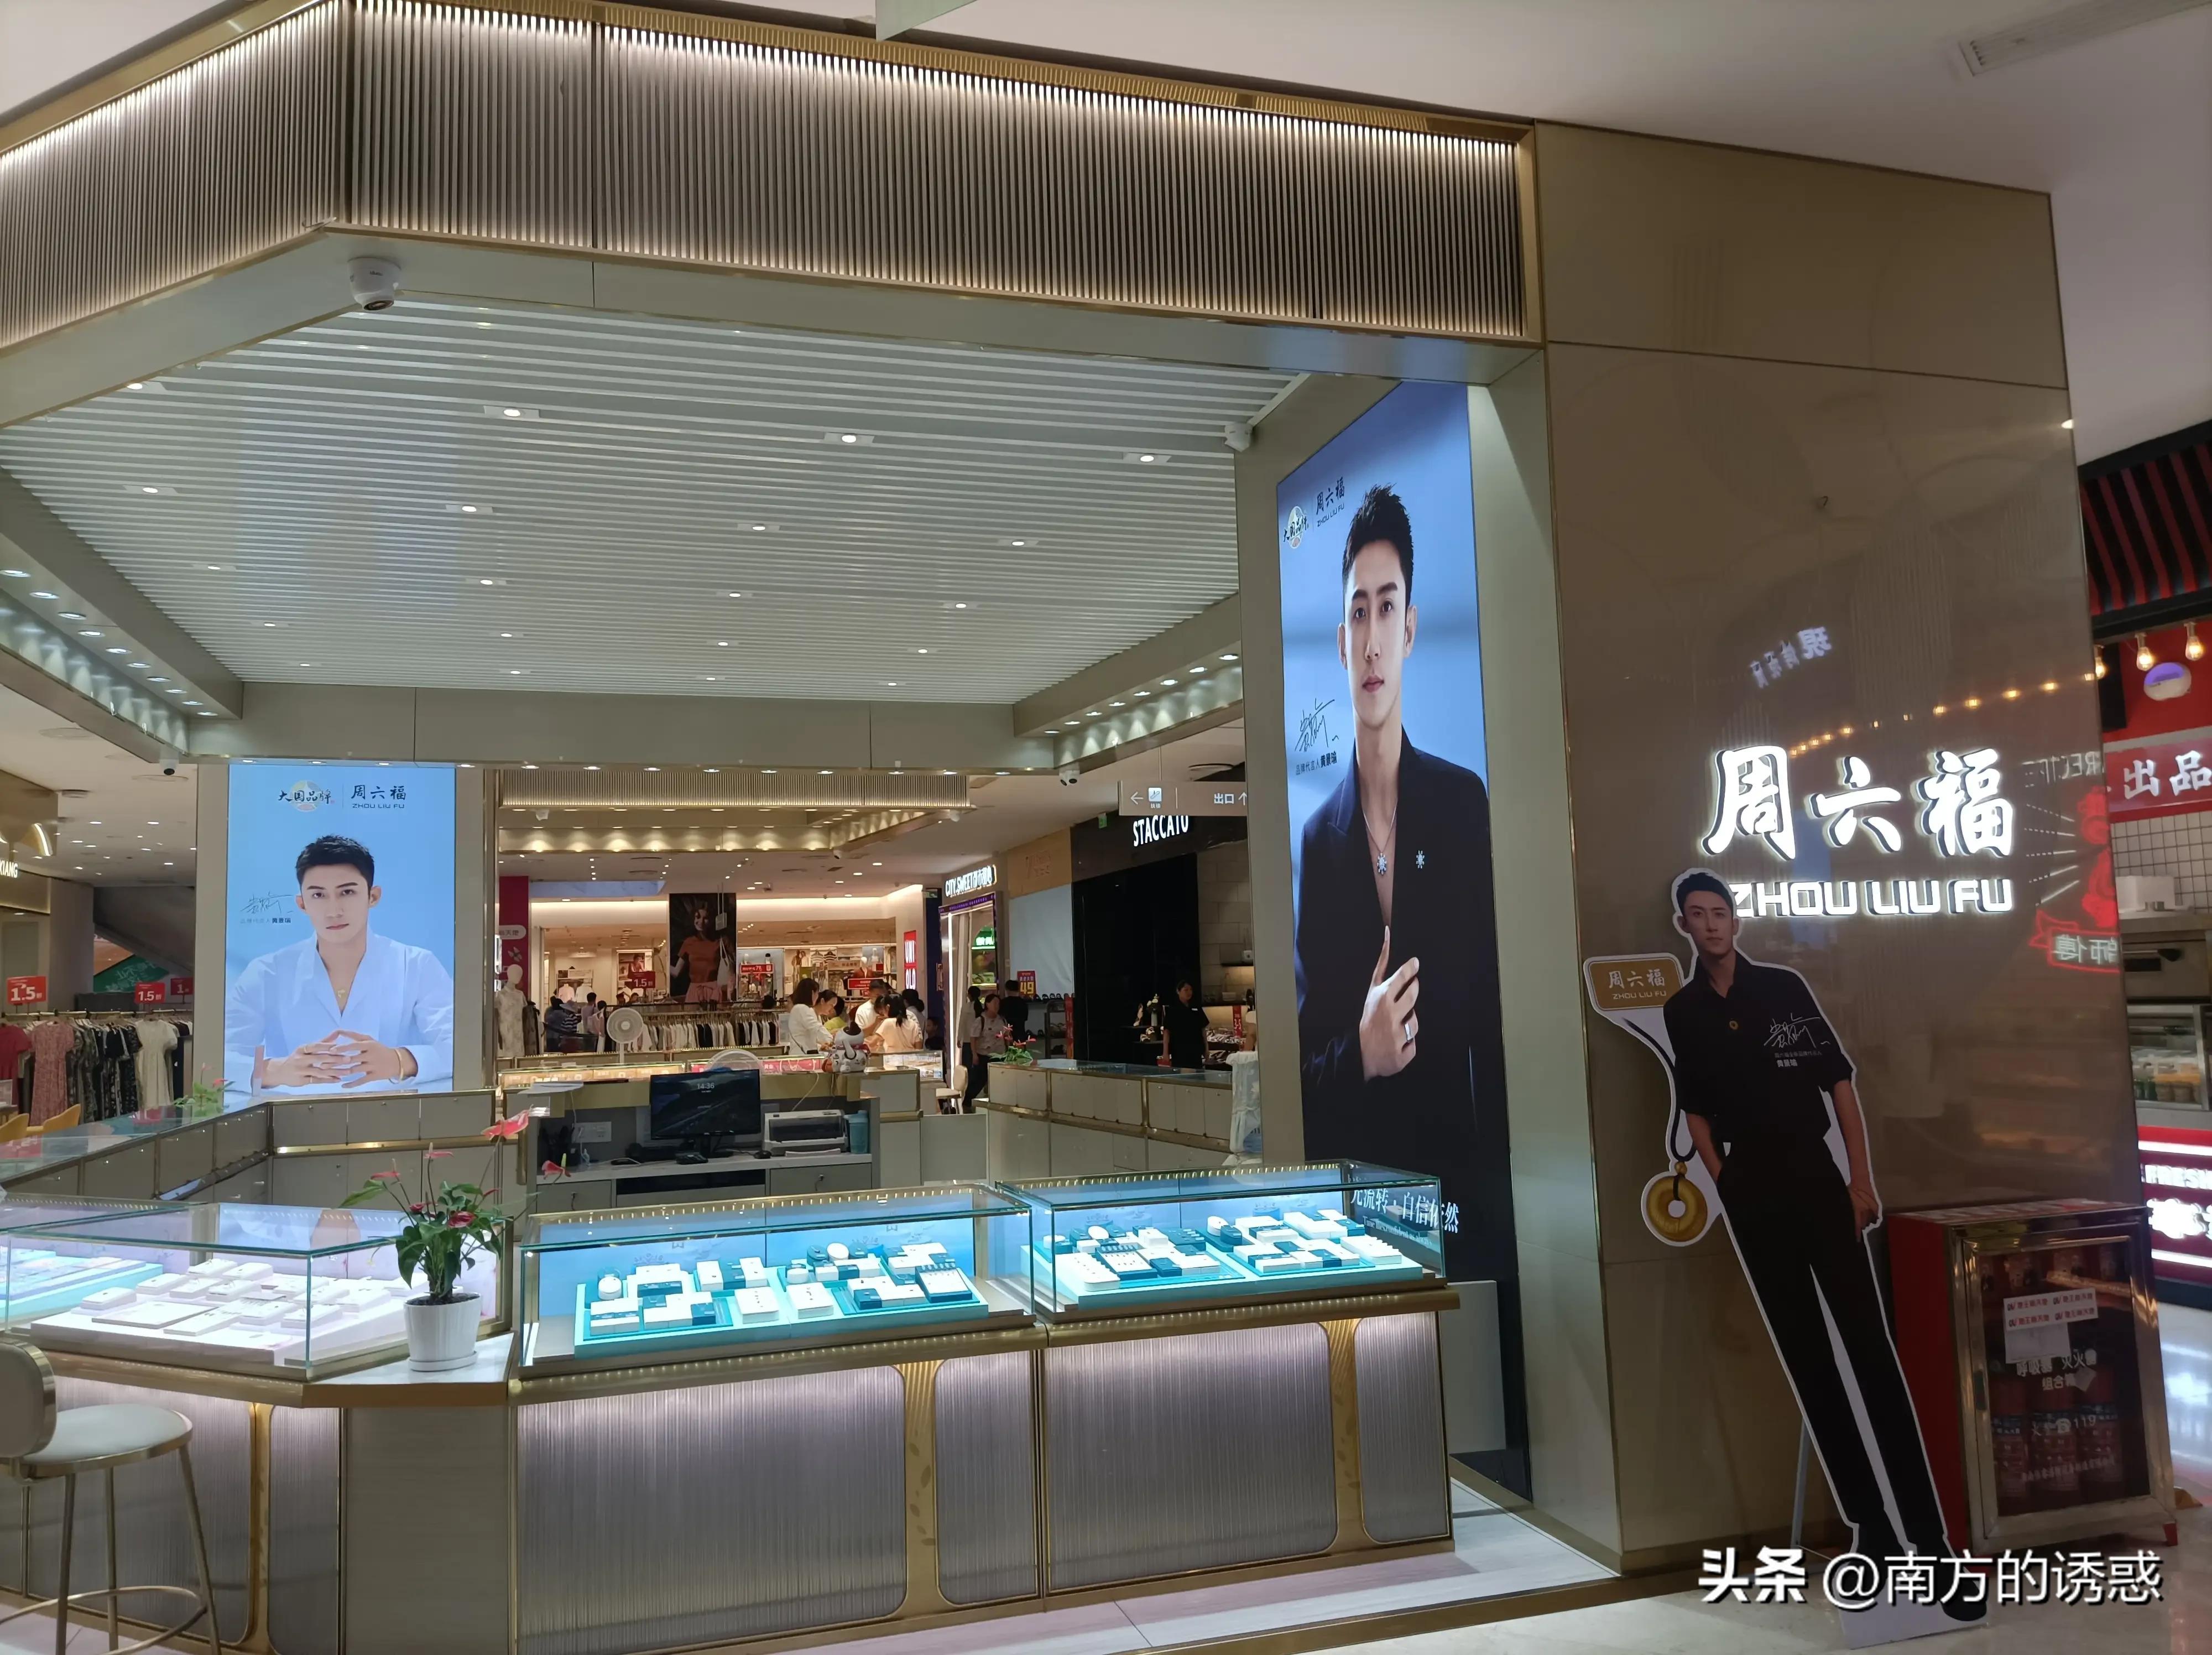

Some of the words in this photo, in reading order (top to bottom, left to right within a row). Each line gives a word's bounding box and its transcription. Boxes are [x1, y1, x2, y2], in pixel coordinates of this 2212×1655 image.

[1317, 476, 1344, 515] 周六福
[1317, 514, 1329, 527] ZHOU
[1338, 502, 1344, 512] FU
[2124, 750, 2212, 800] 出品
[278, 789, 331, 804] 大国品牌
[351, 784, 406, 800] 周六福
[1214, 793, 1234, 804] 出口
[1700, 745, 2013, 861] 周六福
[1134, 815, 1188, 847] STACCATO
[1730, 881, 1858, 917] ZHOU
[1864, 880, 1940, 916] LIU
[1947, 878, 2013, 914] FU
[1020, 981, 1034, 994] 49
[1609, 969, 1666, 989] 周六福
[2074, 1414, 2096, 1429] 119
